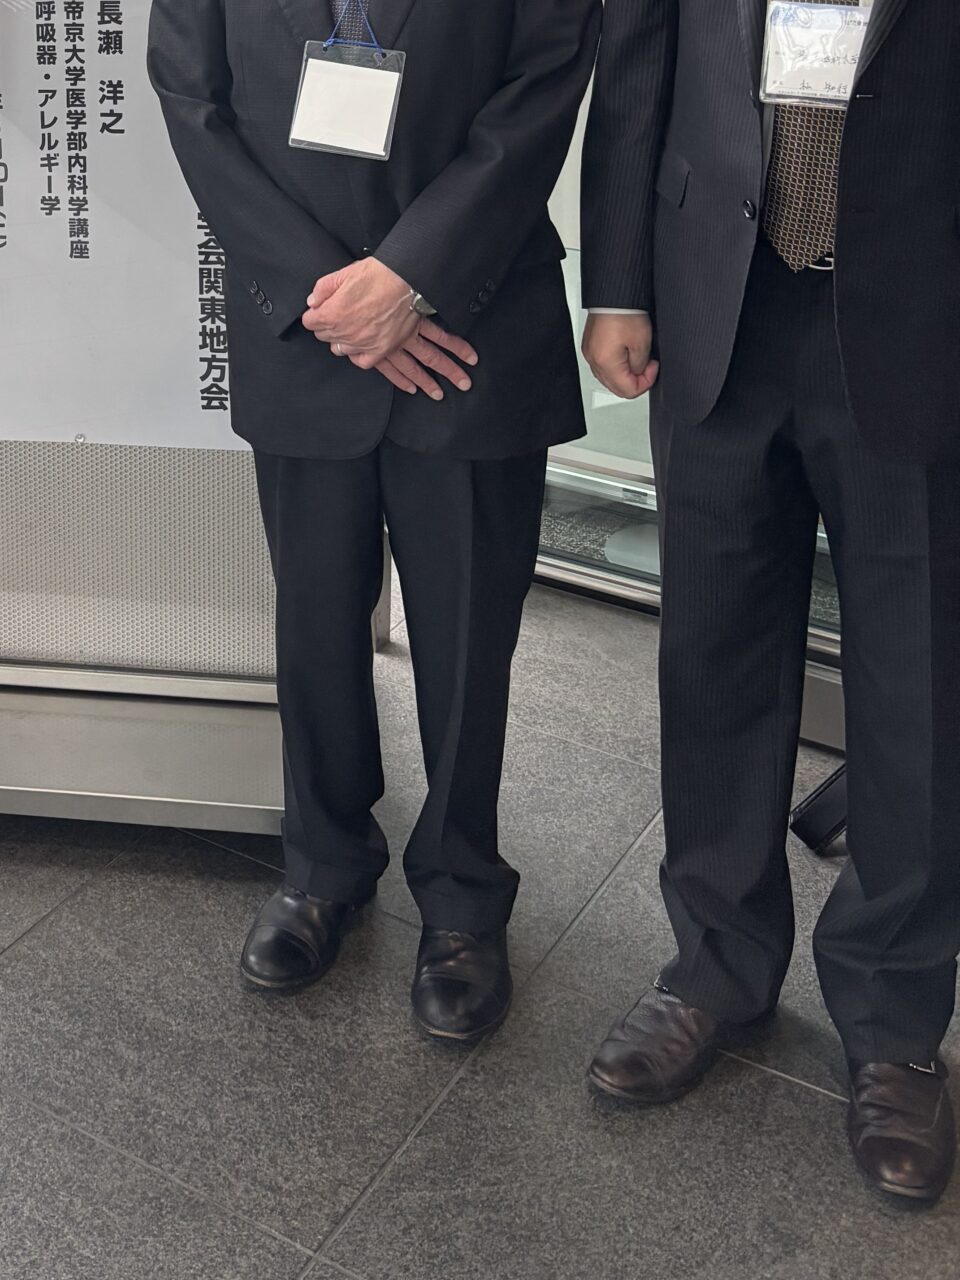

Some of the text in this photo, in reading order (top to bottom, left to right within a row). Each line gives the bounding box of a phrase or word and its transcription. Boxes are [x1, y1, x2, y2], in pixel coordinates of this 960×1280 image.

[97, 1, 124, 55] 長瀬
[35, 0, 61, 216] 呼吸器・アレルギー学
[63, 0, 90, 259] 帝京大学医学部内科学講座
[98, 80, 125, 134] 洋之
